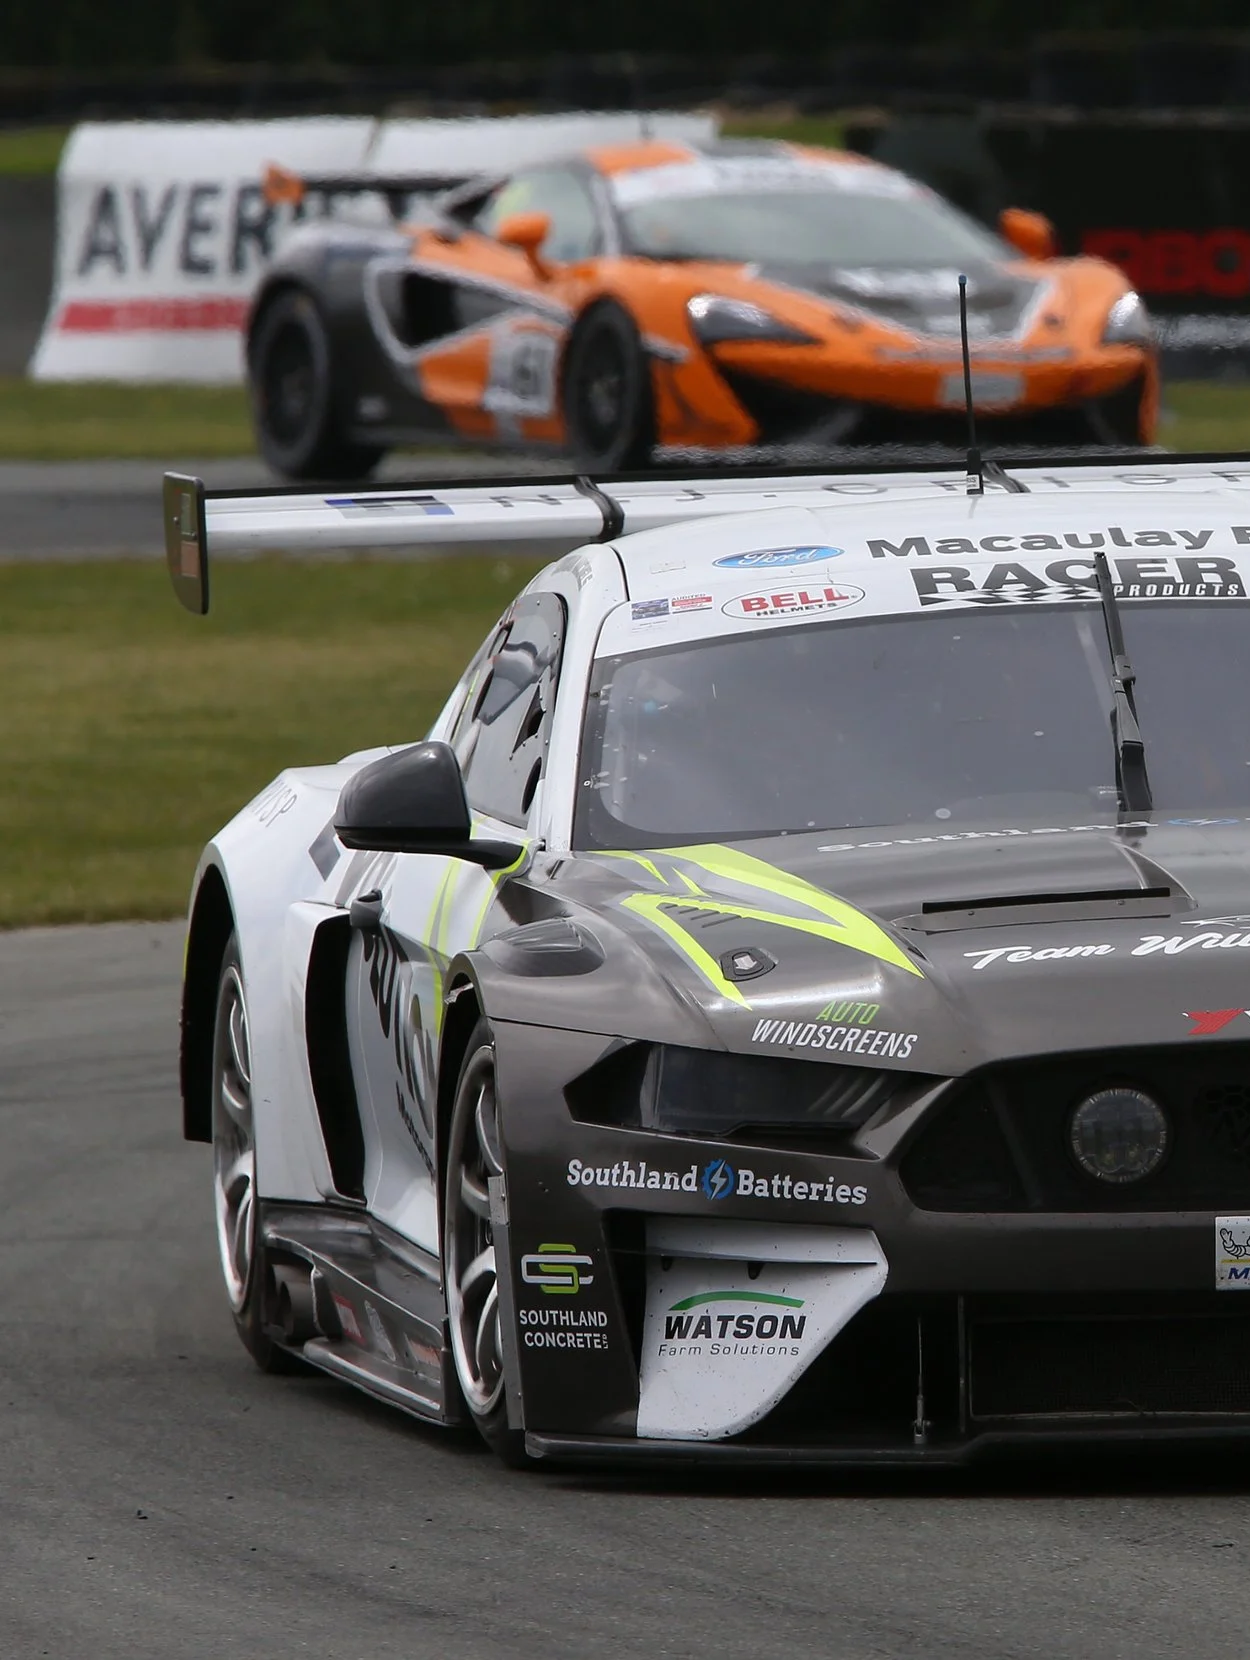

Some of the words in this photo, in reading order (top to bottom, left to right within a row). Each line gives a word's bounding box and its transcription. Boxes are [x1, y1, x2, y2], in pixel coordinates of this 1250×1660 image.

[866, 527, 1215, 558] Macaulay
[737, 548, 818, 567] Ford
[909, 557, 1248, 604] RACER
[1112, 582, 1240, 597] PRODUCTS
[741, 588, 850, 613] BELL
[756, 602, 838, 617] HELMETS
[964, 944, 1115, 969] Team
[816, 1000, 881, 1025] AUTO
[752, 1019, 918, 1059] WINDSCREENS
[567, 1158, 698, 1192] Southland
[736, 1168, 868, 1205] Batteries
[519, 1309, 608, 1328] SOUTHLAND
[664, 1314, 807, 1340] WATSON
[524, 1331, 602, 1349] CONCRETE
[658, 1343, 702, 1357] Farm
[710, 1342, 800, 1357] Solutions
